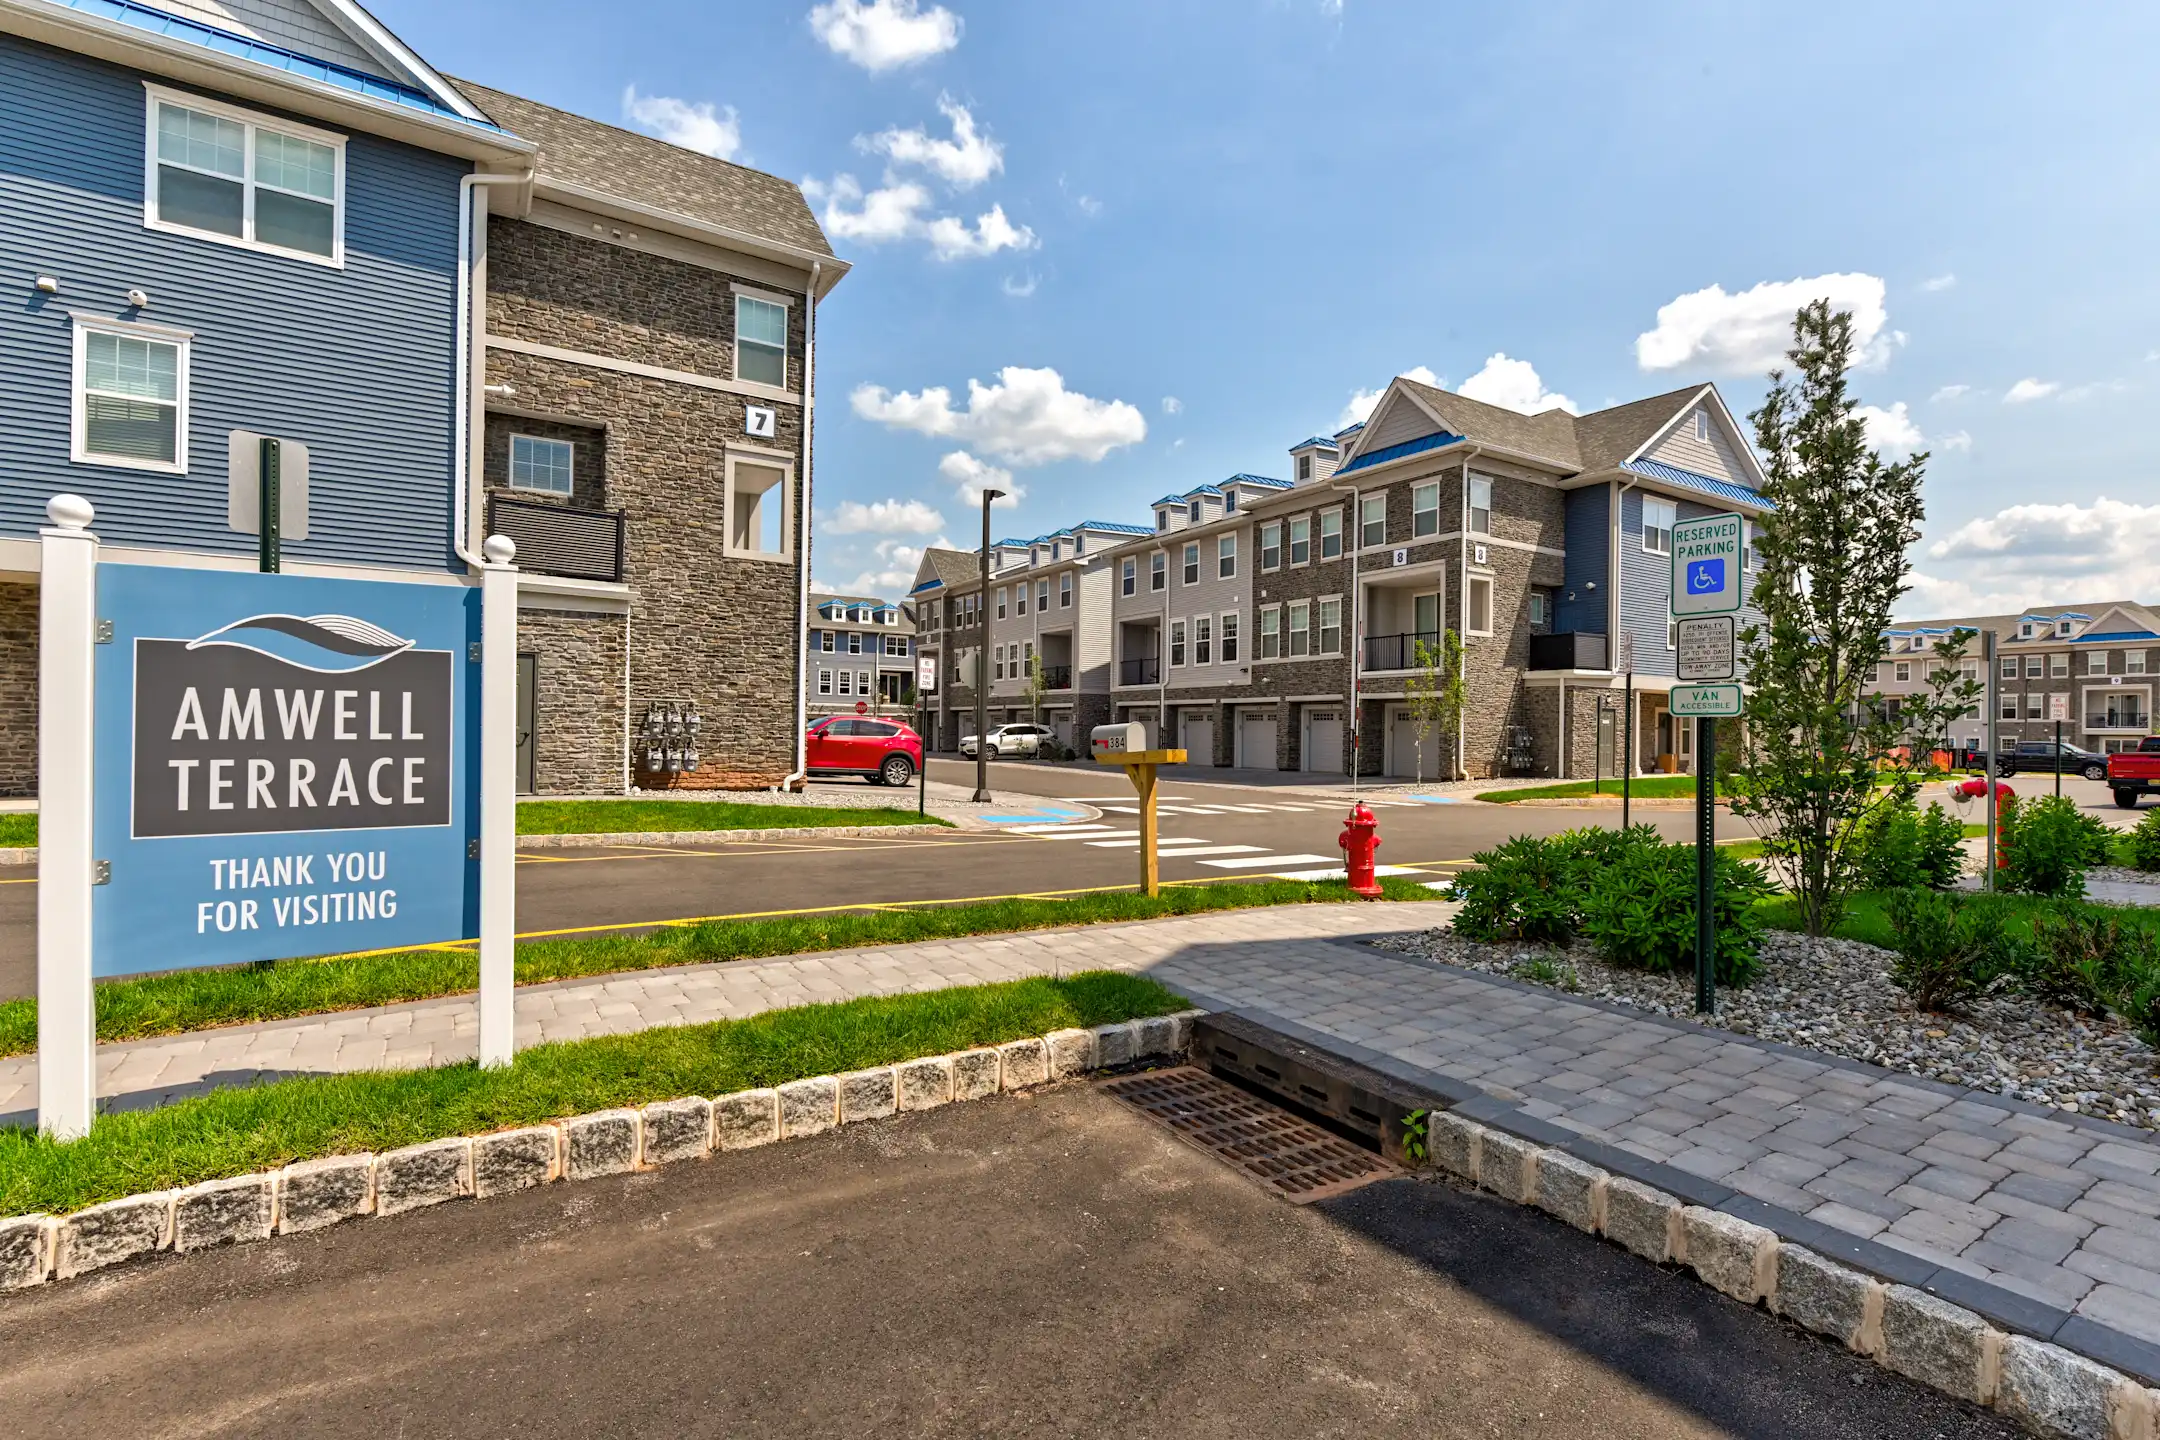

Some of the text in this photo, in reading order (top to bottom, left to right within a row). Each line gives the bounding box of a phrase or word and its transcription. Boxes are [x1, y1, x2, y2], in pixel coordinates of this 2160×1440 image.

[755, 412, 767, 430] 7
[1677, 524, 1736, 542] RESERVED
[1397, 552, 1404, 563] 8
[1478, 549, 1484, 560] 8
[1679, 540, 1733, 558] PARKING
[1686, 622, 1724, 631] PENALTY
[1692, 691, 1719, 701] VAN
[171, 686, 424, 740] AMWELL
[1681, 702, 1731, 710] ACCESSIBLE
[1110, 737, 1125, 748] 384
[168, 757, 425, 811] TERRACE
[209, 851, 386, 891] THANK YOU
[197, 889, 397, 934] FOR VISITING
